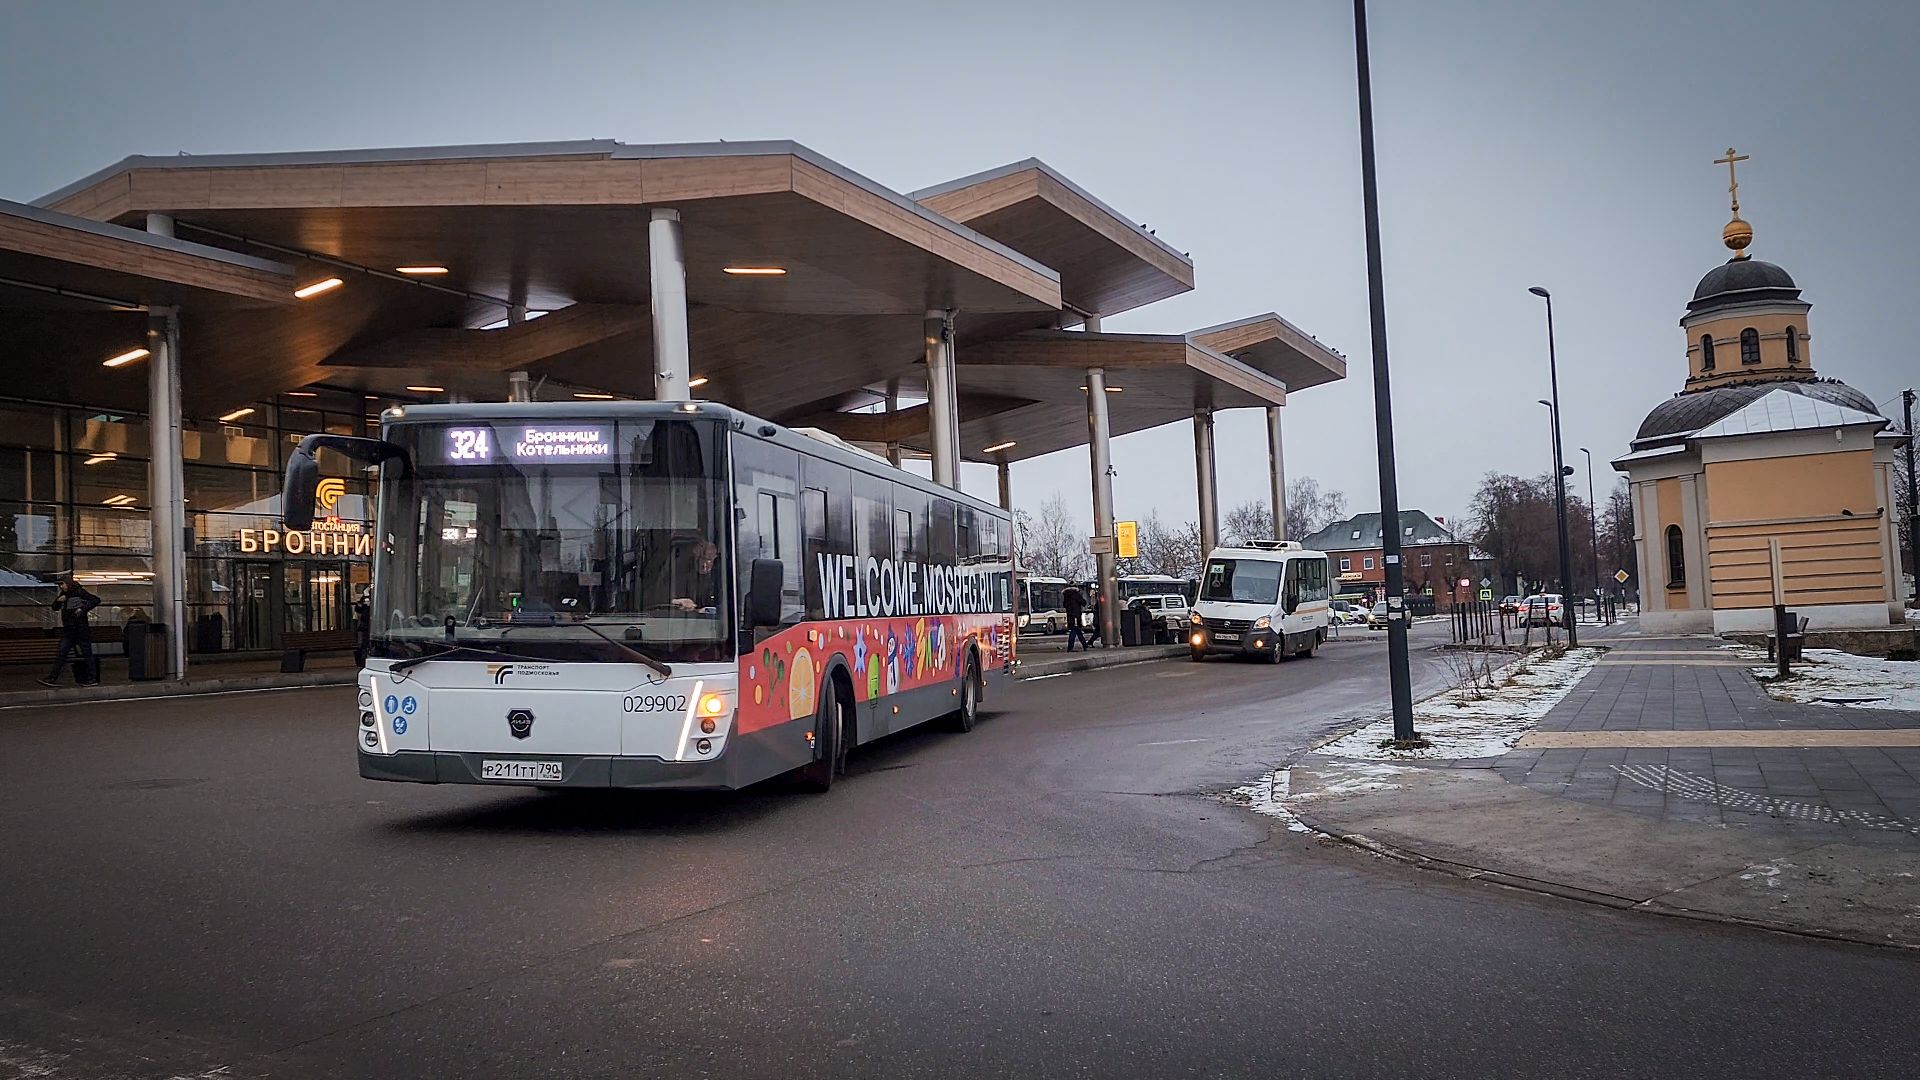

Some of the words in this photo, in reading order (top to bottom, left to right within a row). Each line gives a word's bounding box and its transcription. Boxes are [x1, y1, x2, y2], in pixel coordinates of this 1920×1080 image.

[450, 430, 489, 459] 324
[525, 429, 599, 444] Бронницы
[516, 442, 608, 456] Котельники
[623, 695, 687, 713] 029902
